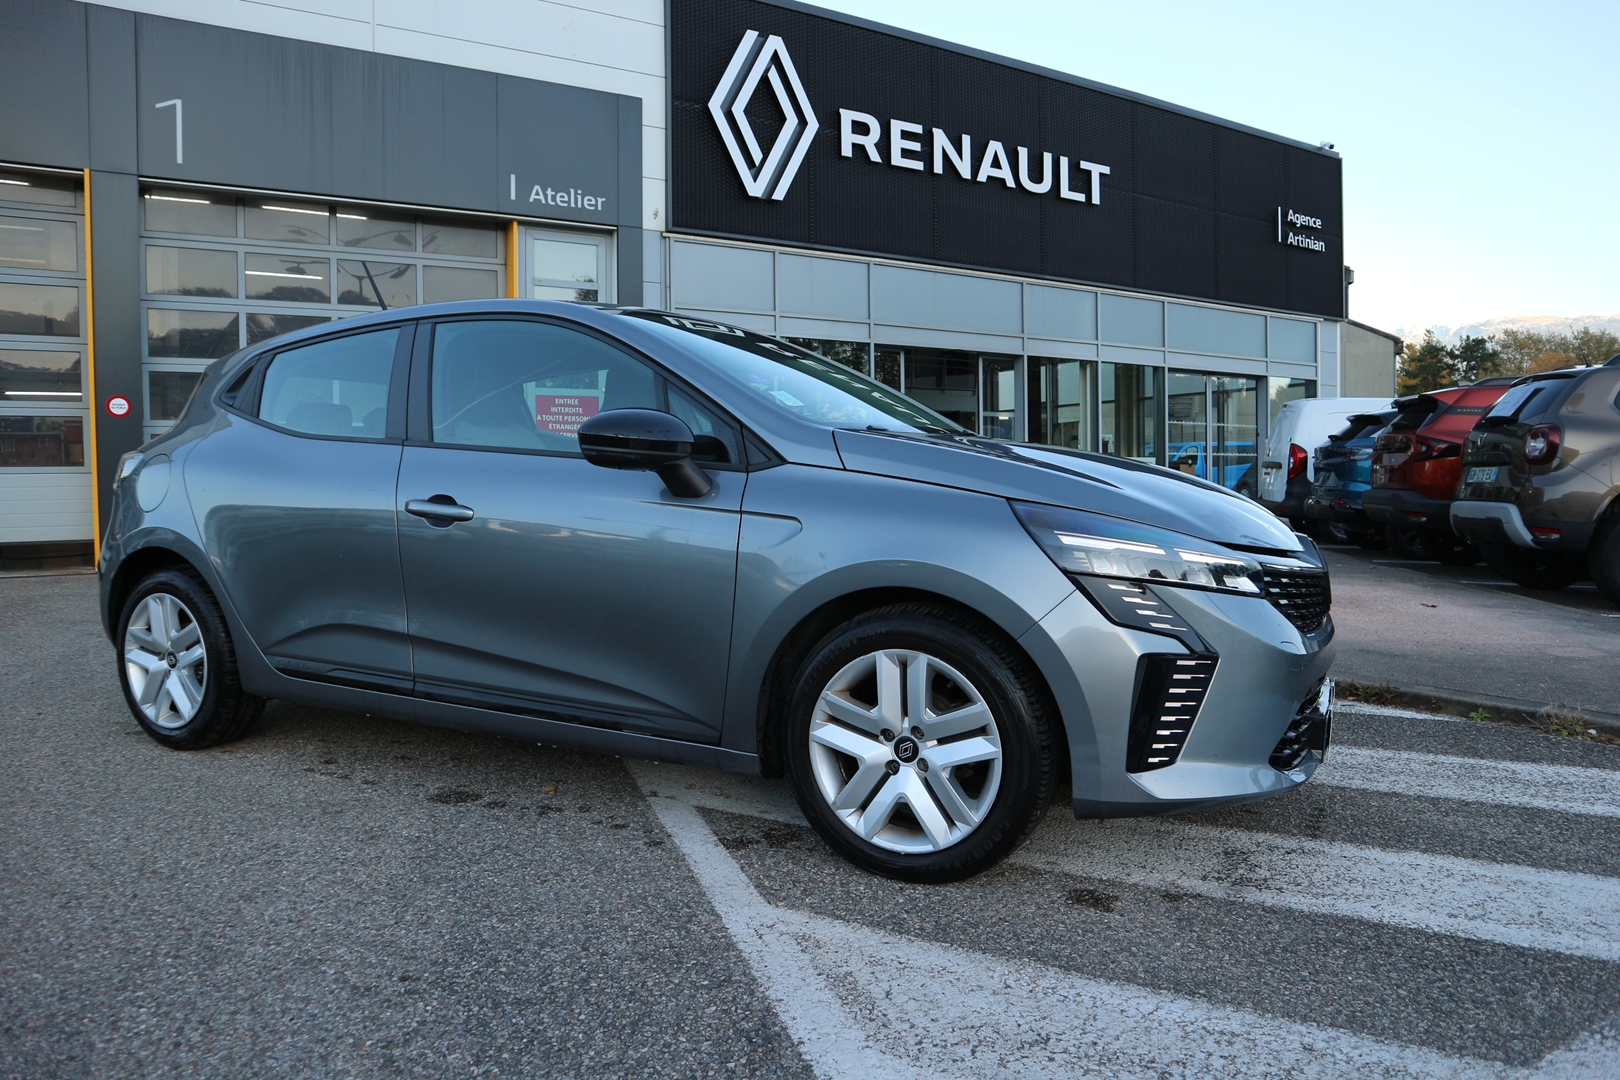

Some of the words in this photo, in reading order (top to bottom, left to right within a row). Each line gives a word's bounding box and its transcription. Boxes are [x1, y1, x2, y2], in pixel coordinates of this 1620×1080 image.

[155, 98, 183, 164] 1
[839, 108, 1111, 205] RENAULT
[529, 184, 606, 211] Atelier
[1287, 209, 1322, 228] Agence
[1287, 231, 1326, 252] Artinian
[549, 422, 582, 430] ÉTRANGÈ
[277, 659, 311, 671] CLIO
